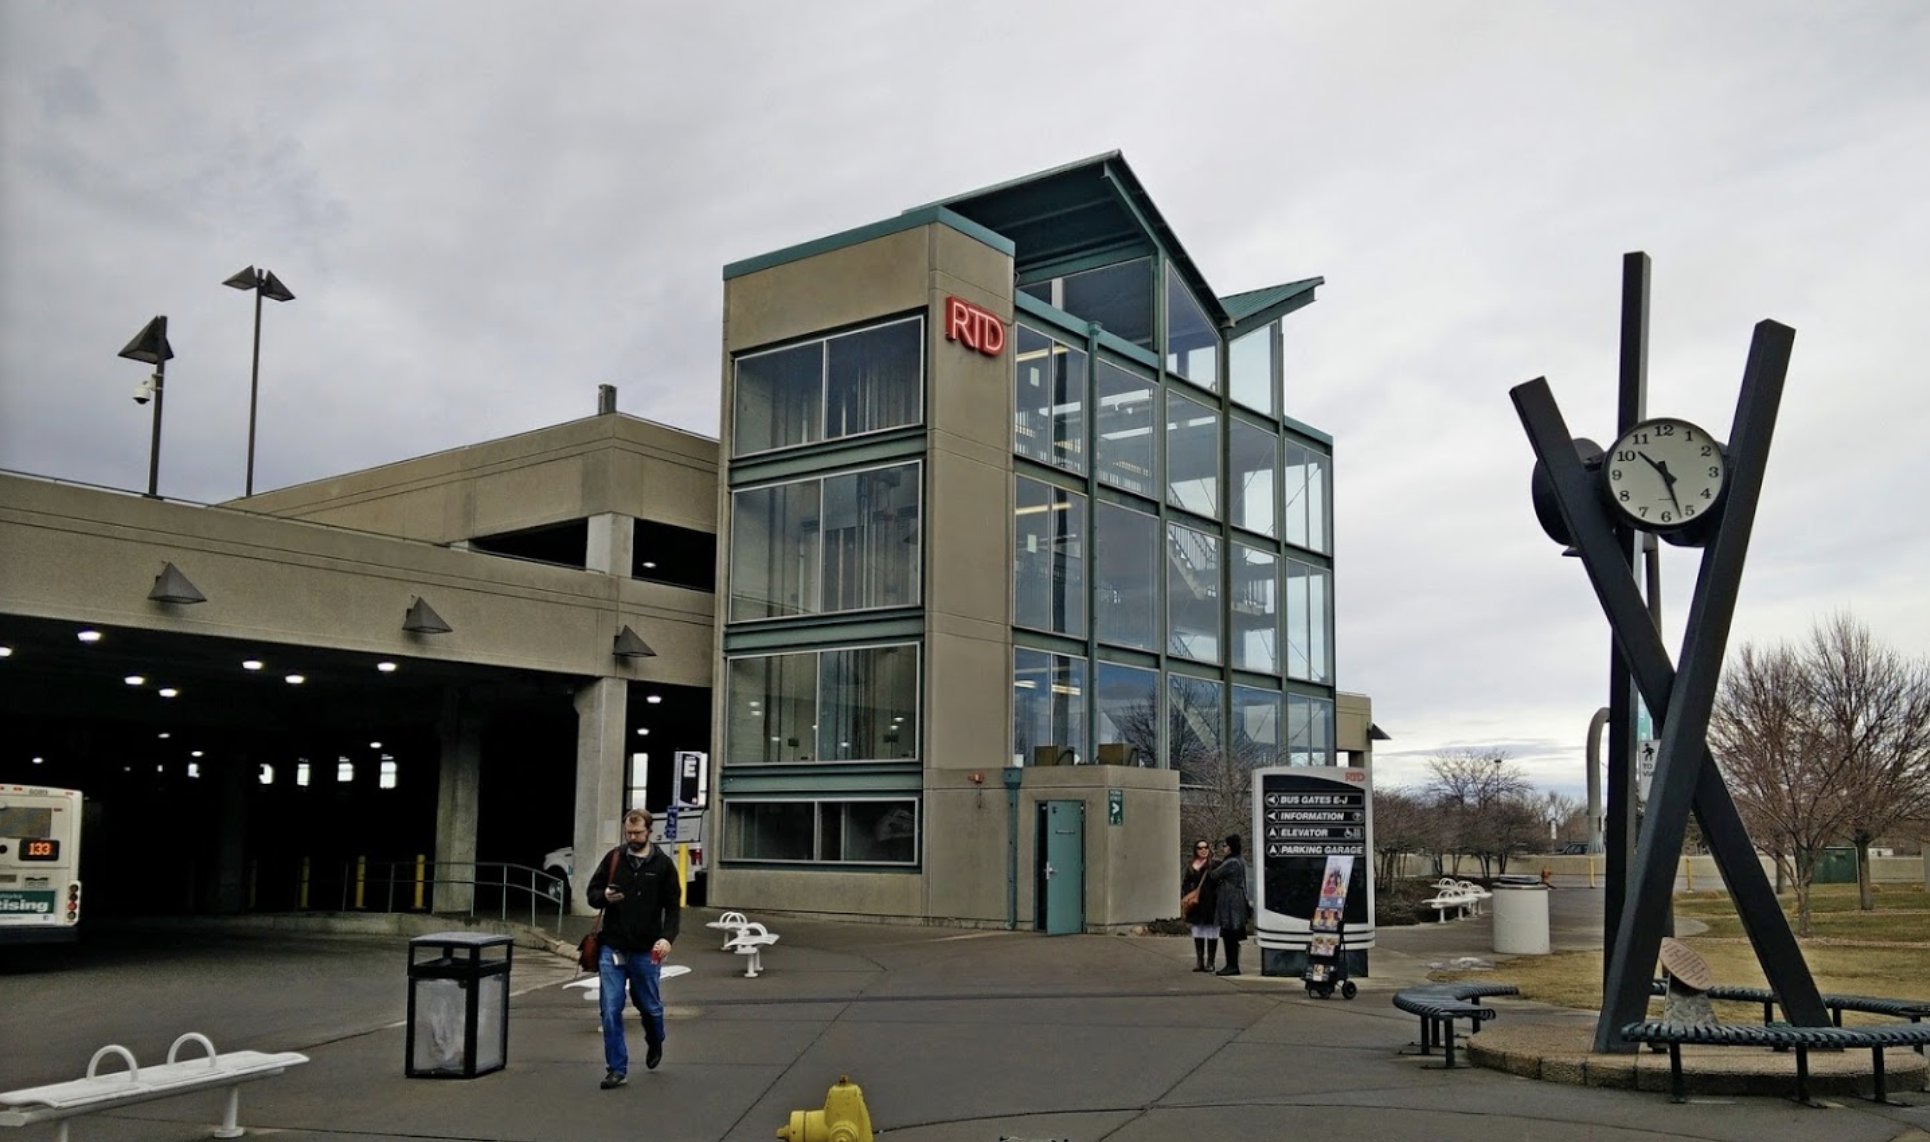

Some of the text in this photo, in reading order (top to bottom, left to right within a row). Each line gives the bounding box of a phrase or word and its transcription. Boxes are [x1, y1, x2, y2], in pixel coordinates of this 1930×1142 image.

[946, 296, 1006, 356] RTD
[1655, 425, 1674, 436] 12
[1685, 431, 1693, 441] 1
[1633, 434, 1649, 445] 11
[1617, 451, 1636, 462] 10
[1701, 446, 1712, 457] 2
[1612, 470, 1622, 481] 9
[1709, 467, 1719, 478] 3
[1619, 491, 1630, 502] 8
[1701, 488, 1712, 499] 4
[1639, 507, 1649, 517] 7
[1685, 505, 1695, 516] 5
[1661, 511, 1672, 522] 6
[683, 760, 697, 777] E
[1344, 772, 1364, 782] RTD
[1280, 796, 1348, 804] BUS GATES E-J
[1281, 812, 1344, 820] INFORMATION
[29, 843, 51, 856] 133
[1281, 846, 1364, 854] PARKING GARAGE
